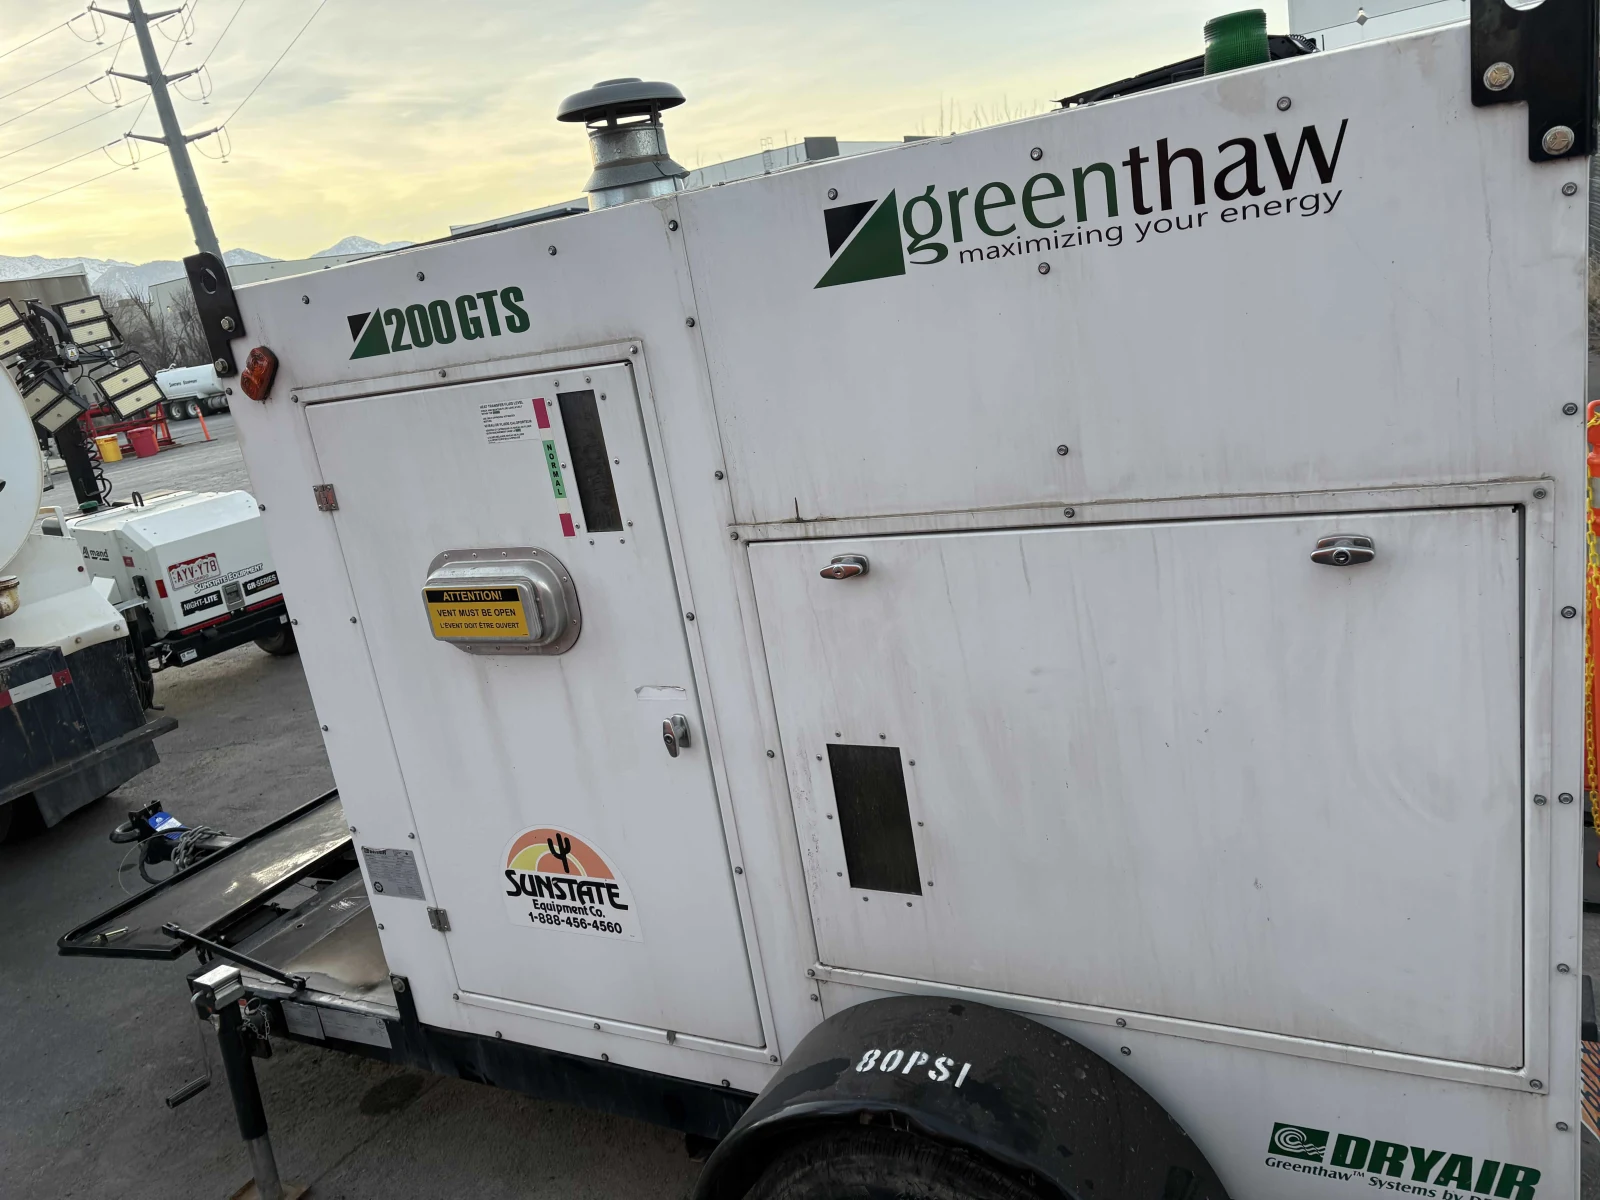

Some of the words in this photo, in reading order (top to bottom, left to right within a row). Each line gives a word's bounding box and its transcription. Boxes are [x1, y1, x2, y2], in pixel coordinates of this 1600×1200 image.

[902, 118, 1350, 266] greenthaw
[958, 222, 1124, 264] maximizing
[1135, 210, 1209, 244] your
[1220, 188, 1344, 224] energy
[547, 443, 563, 496] NORMAL
[228, 562, 264, 581] EQUIPMENT
[183, 593, 219, 611] NIGHT-LITE
[443, 590, 503, 602] ATTENTION!
[437, 609, 457, 617] VENT
[459, 609, 480, 617] MUST
[481, 608, 492, 617] BE
[494, 608, 516, 617] OPEN
[505, 869, 629, 911] SUNSTATE
[532, 898, 589, 915] Equipment
[589, 905, 606, 919] Co.
[528, 911, 623, 935] 1-888-456-4560
[1330, 1133, 1542, 1200] DRYAIR
[1368, 1176, 1438, 1198] Systems
